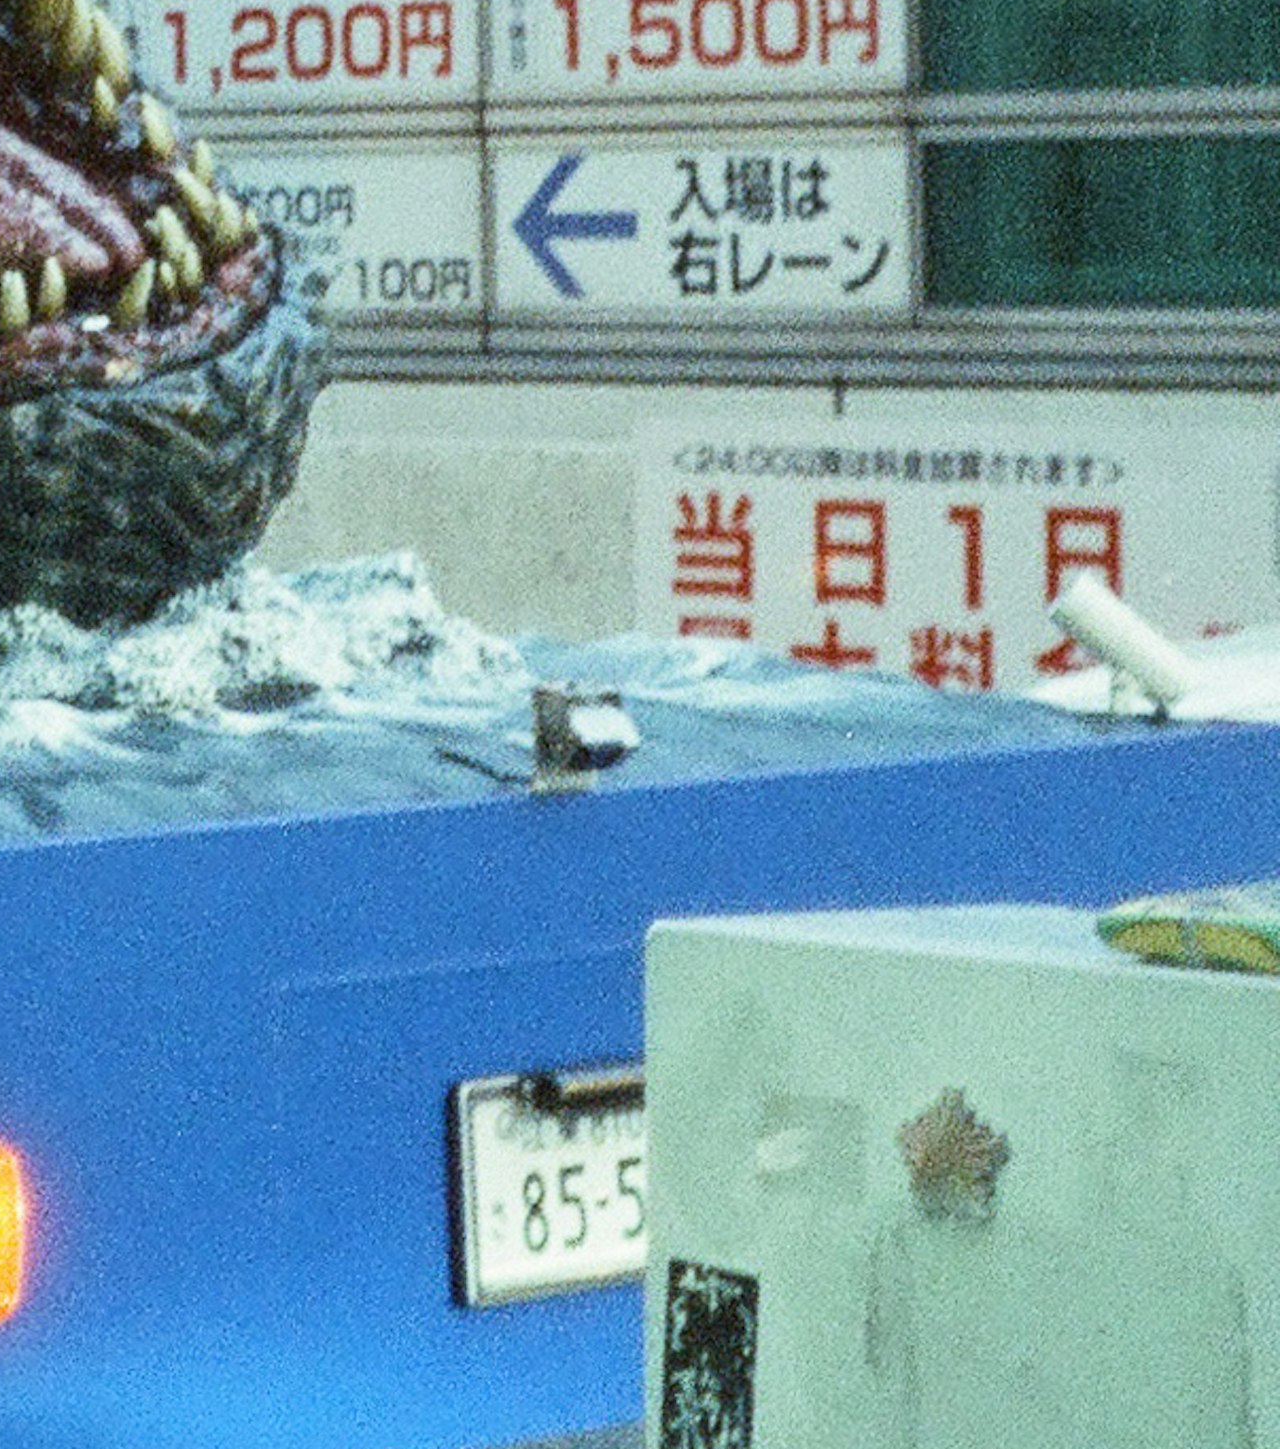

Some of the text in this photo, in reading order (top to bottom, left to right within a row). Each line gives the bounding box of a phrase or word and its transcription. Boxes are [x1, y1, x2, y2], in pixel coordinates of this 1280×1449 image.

[161, 0, 453, 95] 1,200円
[669, 156, 831, 223] 入場は
[669, 234, 892, 300] 右レーン
[523, 1157, 644, 1252] 85-5
